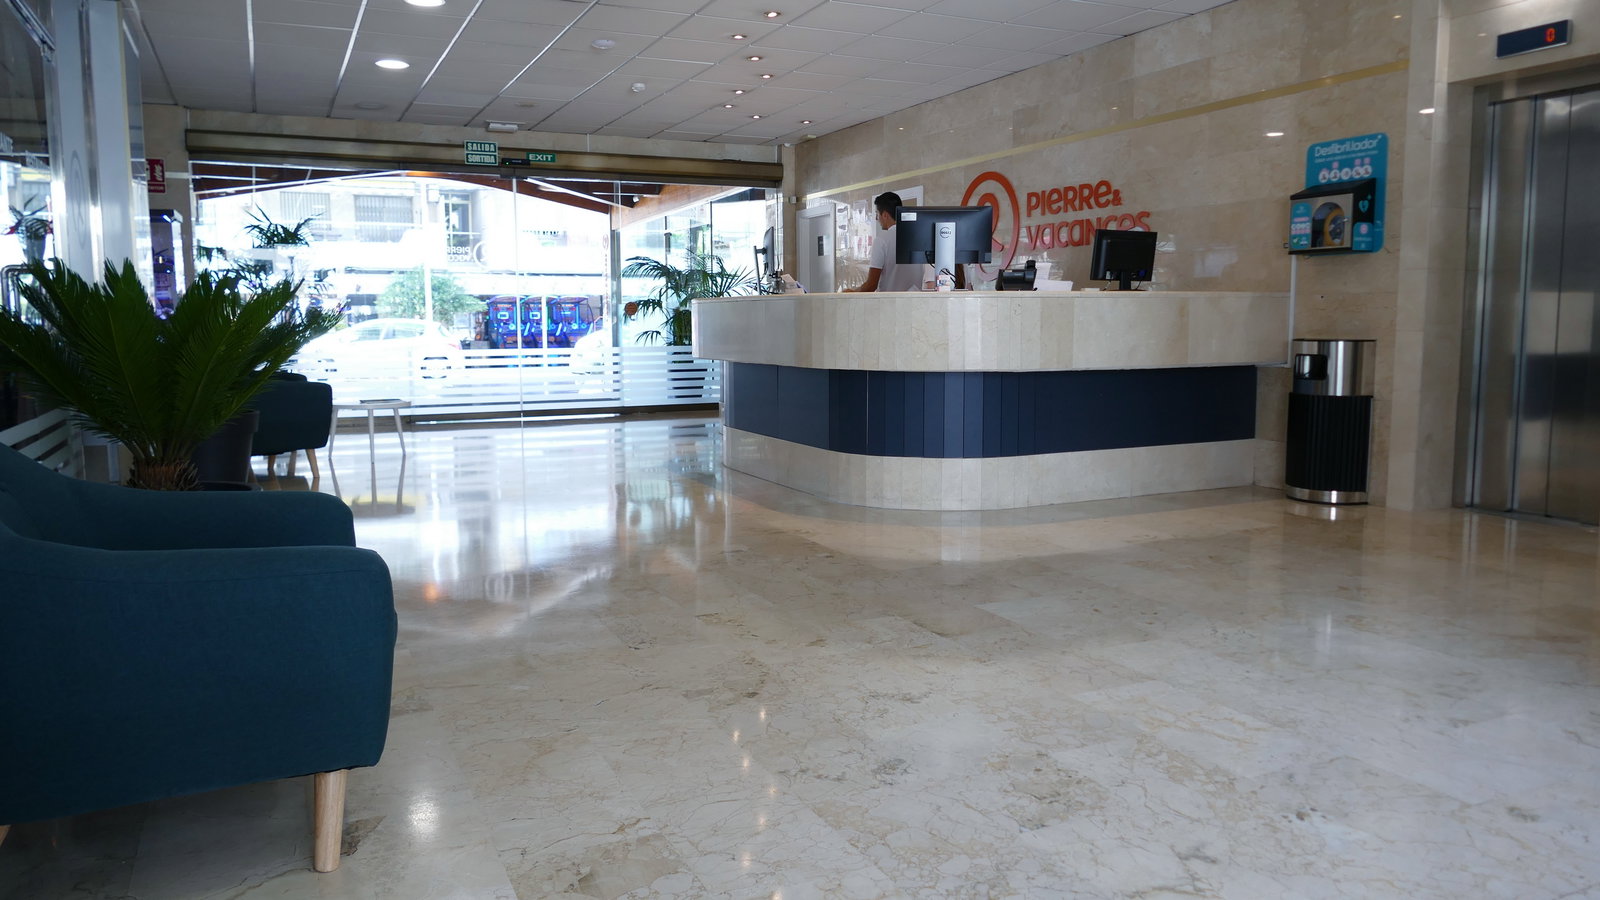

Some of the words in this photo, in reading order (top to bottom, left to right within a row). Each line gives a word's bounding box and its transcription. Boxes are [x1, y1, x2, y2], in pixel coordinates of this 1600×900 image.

[467, 142, 495, 152] SALIDA
[467, 154, 496, 164] SORTIDA
[529, 153, 553, 161] EXIT
